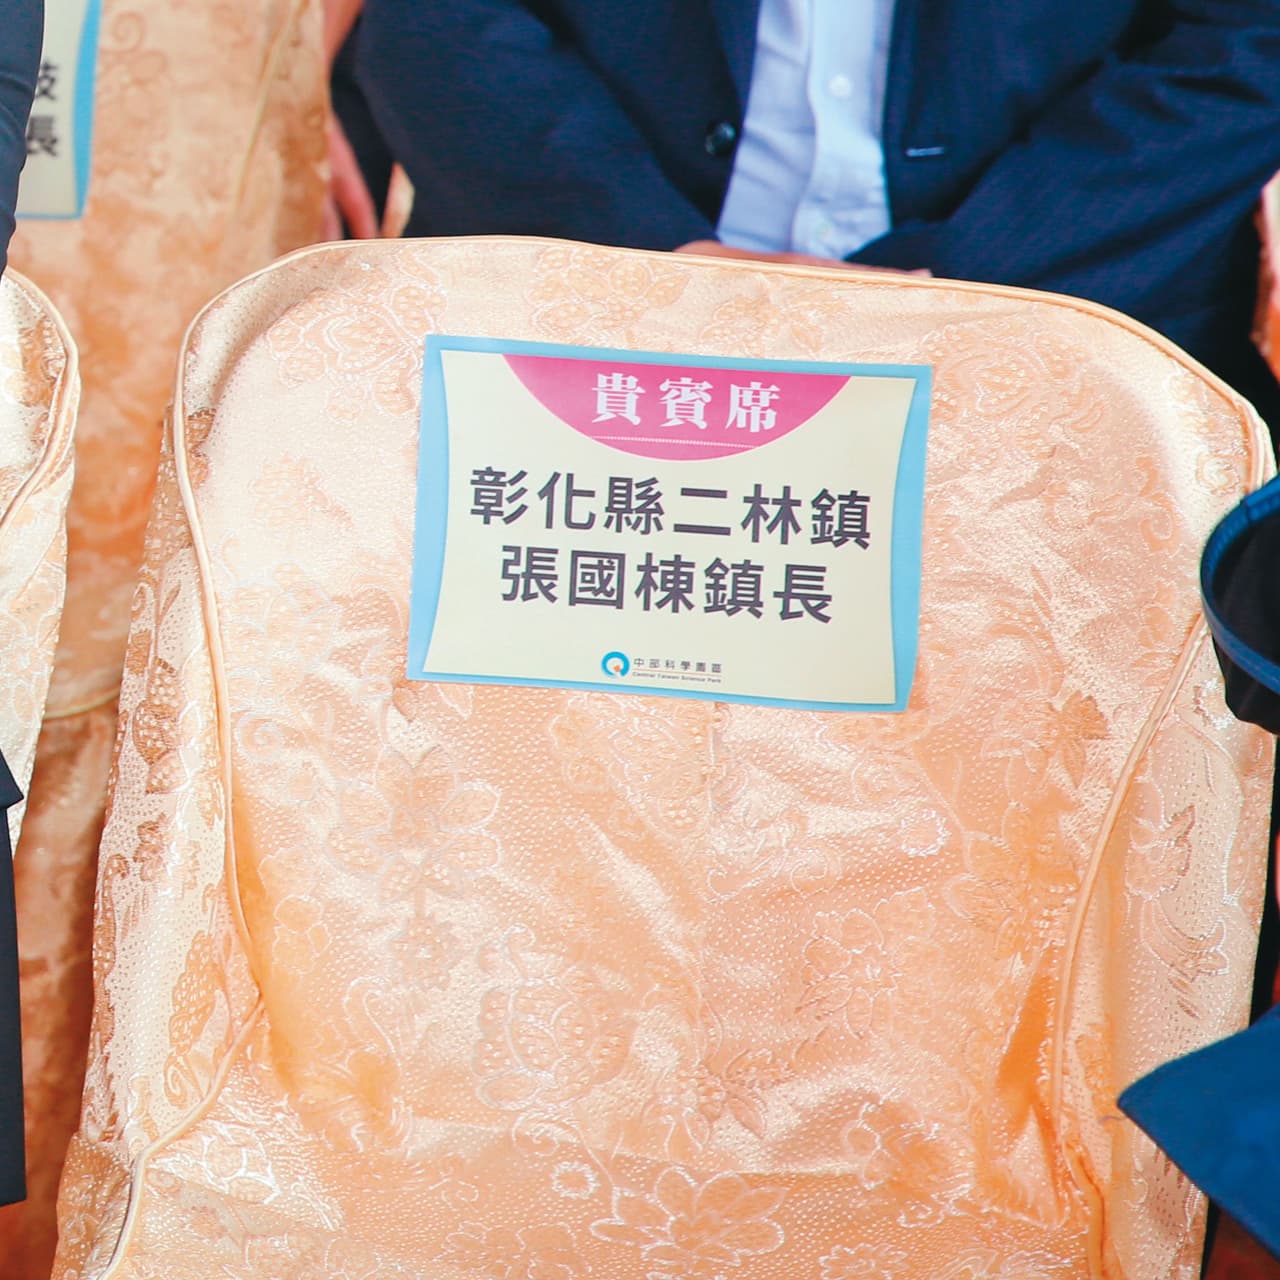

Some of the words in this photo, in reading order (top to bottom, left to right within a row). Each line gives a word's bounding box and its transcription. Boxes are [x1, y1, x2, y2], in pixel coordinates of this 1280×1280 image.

[591, 372, 781, 433] 貴賓席
[469, 466, 871, 550] 彰化縣二林鎮
[501, 545, 833, 623] 張國棟鎮長
